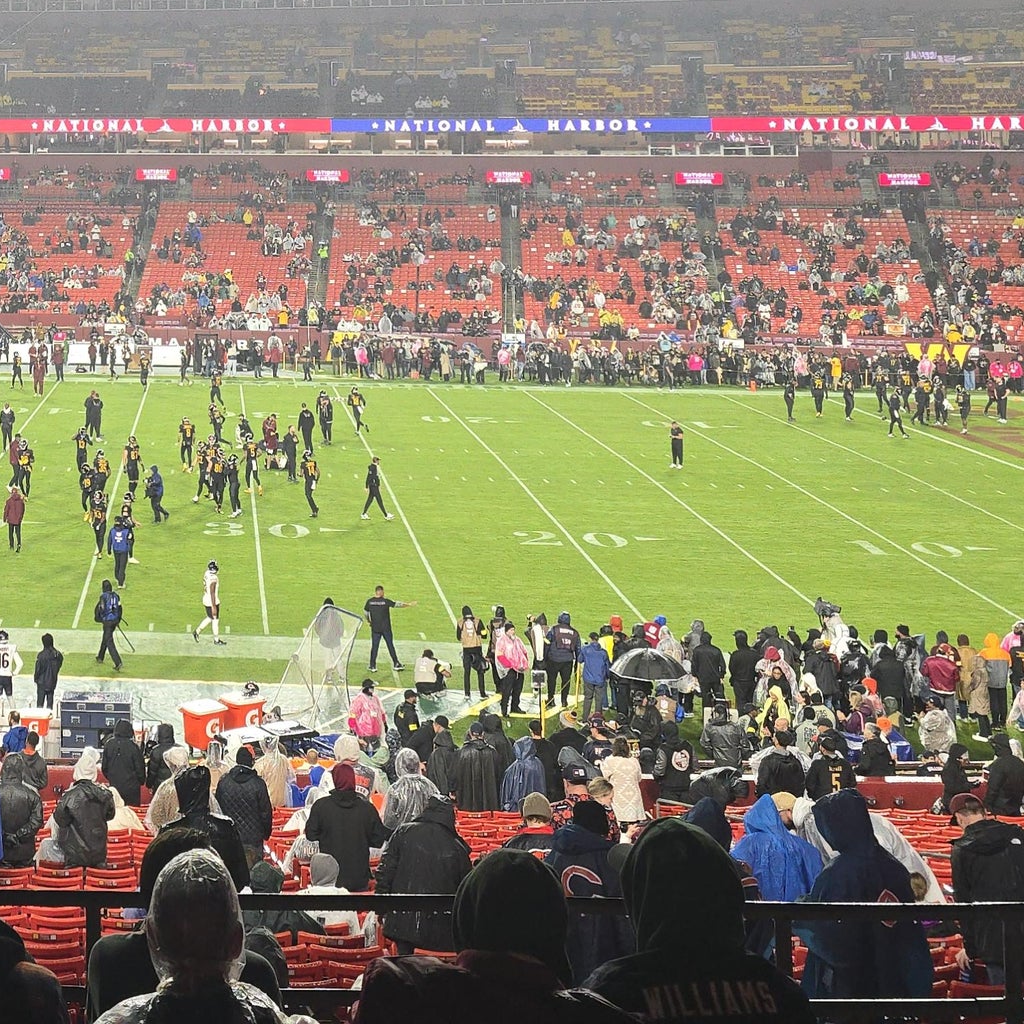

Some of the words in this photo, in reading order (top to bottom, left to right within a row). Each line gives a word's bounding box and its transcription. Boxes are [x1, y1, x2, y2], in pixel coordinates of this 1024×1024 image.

[44, 120, 144, 132] NATIONAL
[193, 120, 273, 132] HARBOR
[385, 120, 495, 132] NATIONAL
[548, 120, 638, 132] HARBOR
[785, 118, 910, 130] NATIONAL
[205, 718, 221, 738] G
[831, 773, 841, 794] 5
[642, 979, 777, 1019] WILLIAMS
